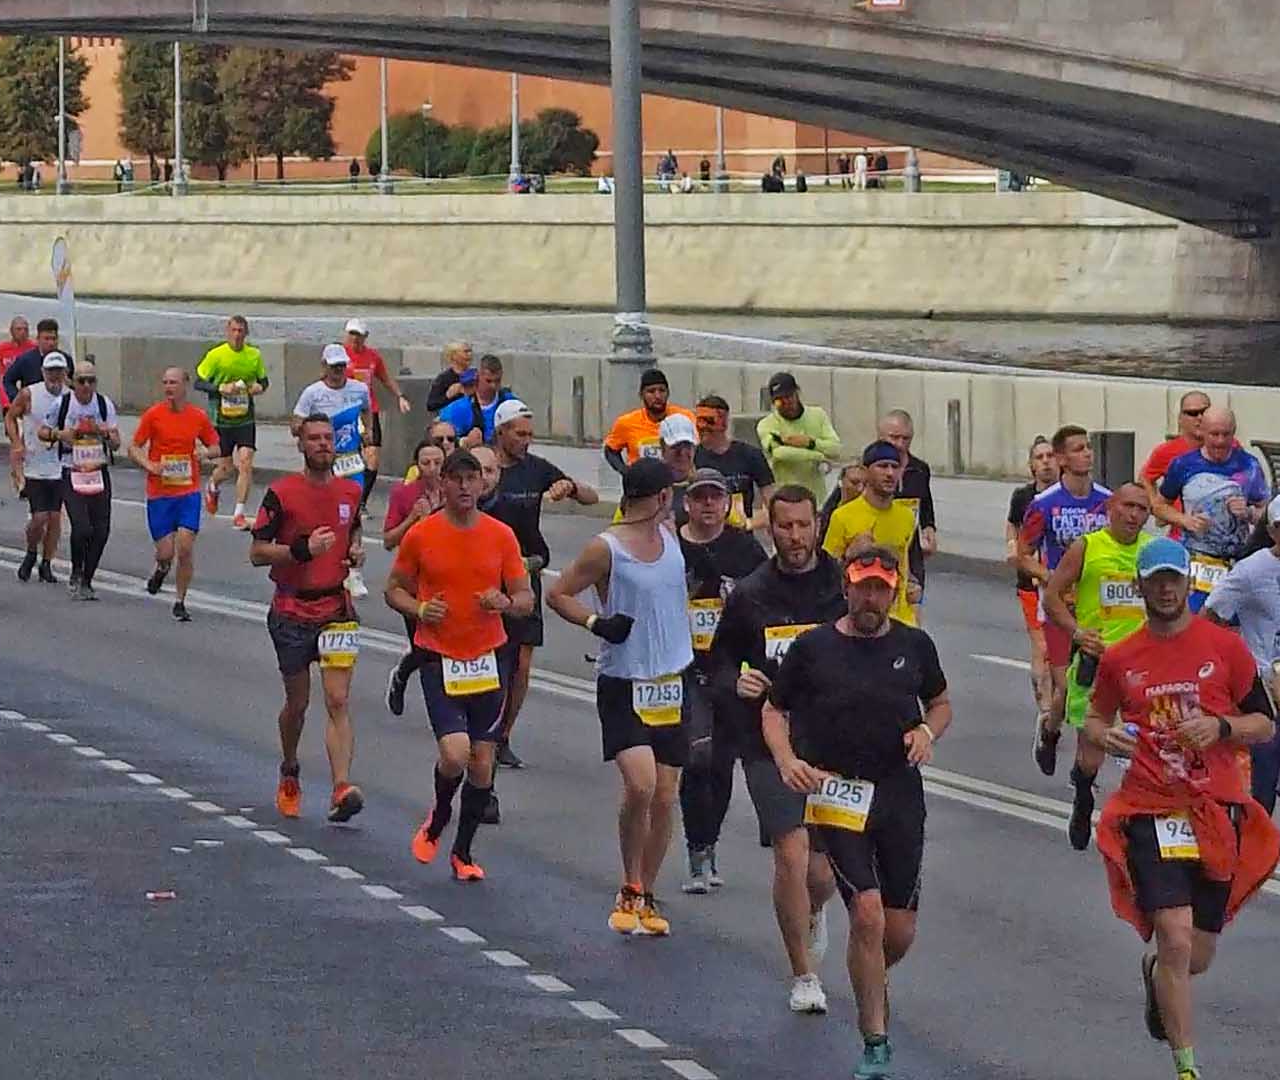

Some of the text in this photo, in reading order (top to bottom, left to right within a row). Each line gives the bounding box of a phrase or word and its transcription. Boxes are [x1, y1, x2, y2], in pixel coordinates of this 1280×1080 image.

[1106, 584, 1142, 599] 800
[696, 612, 720, 627] 33
[637, 684, 681, 703] 17153
